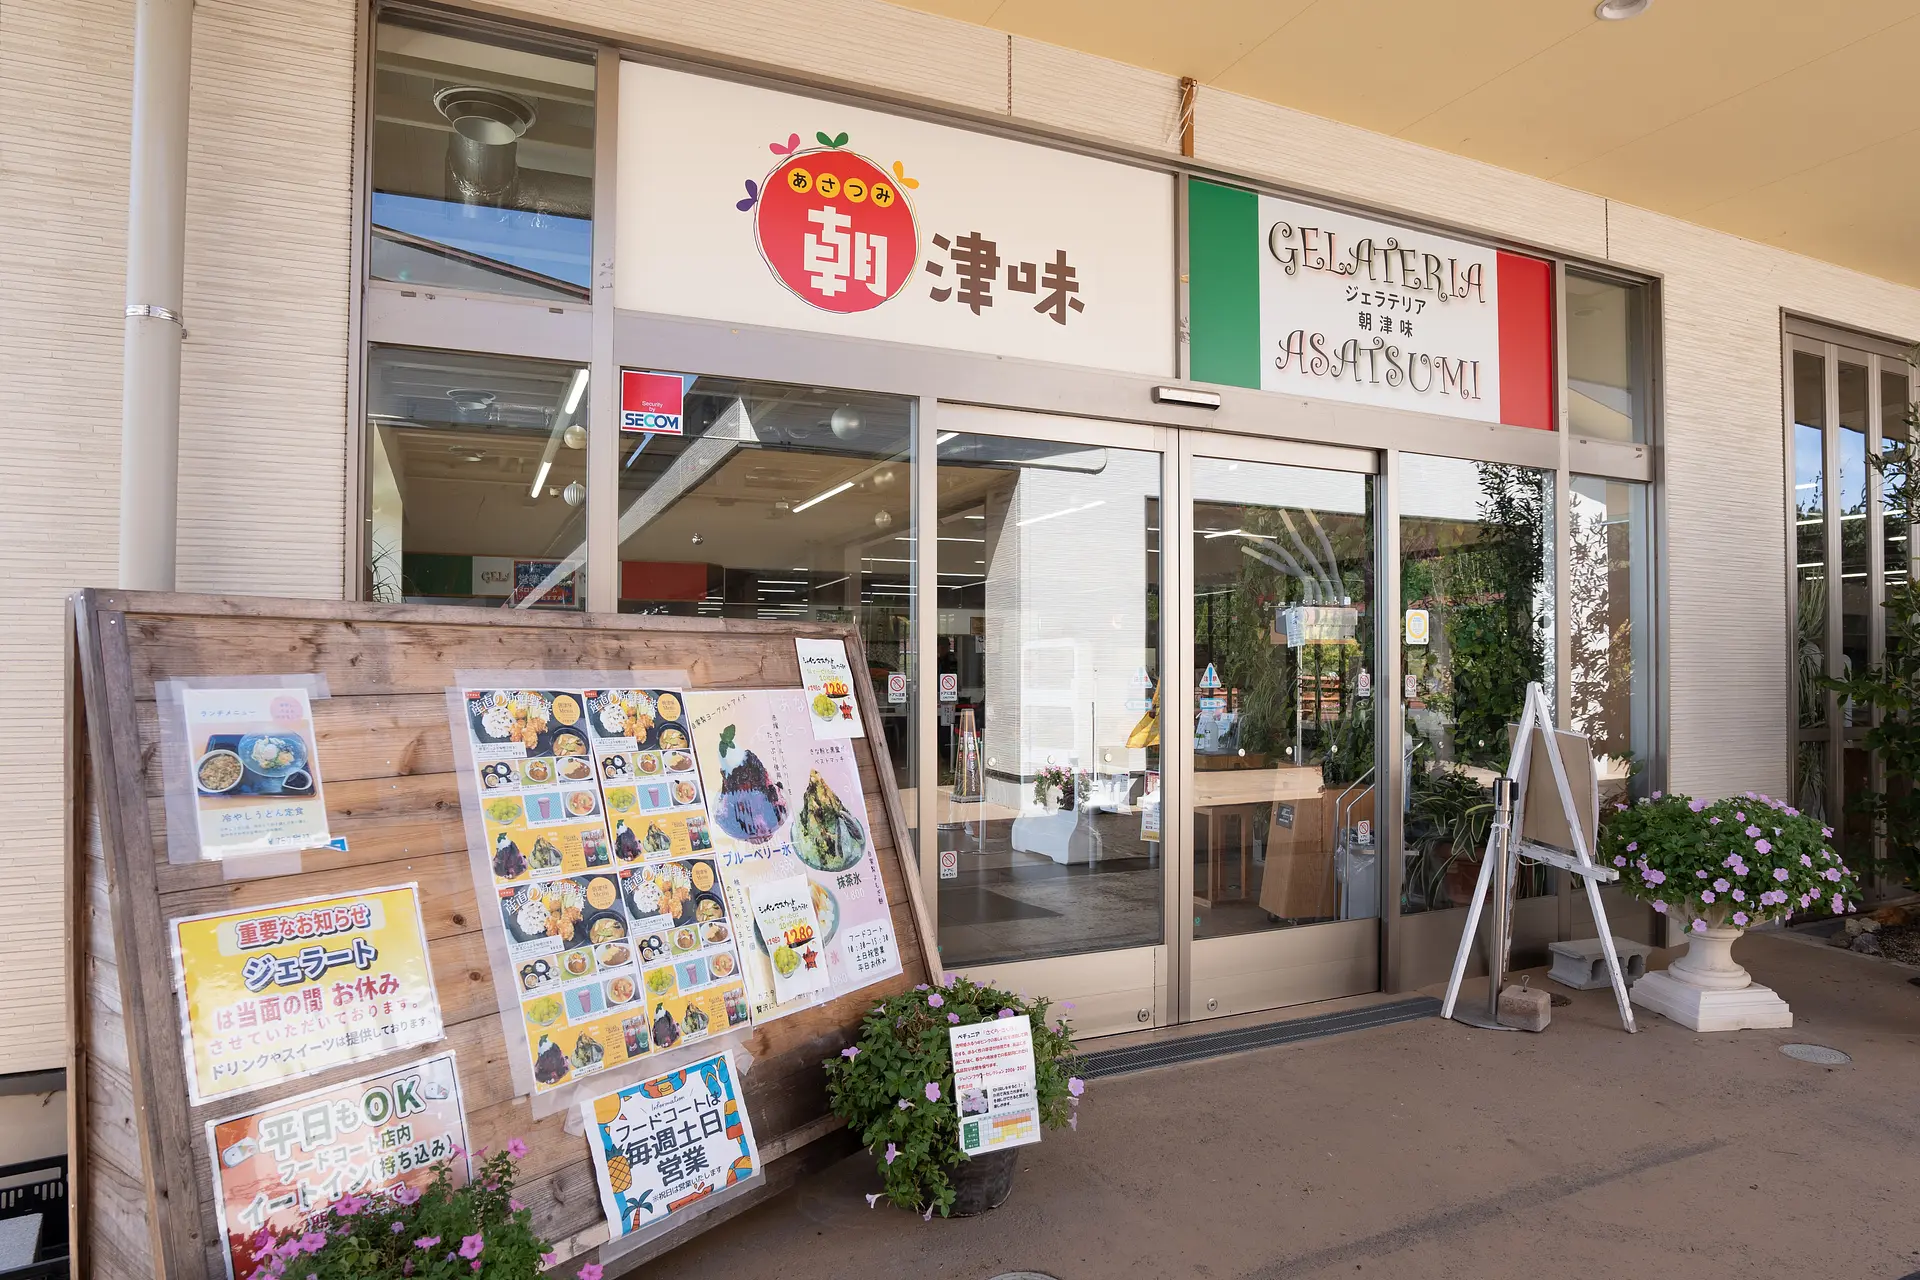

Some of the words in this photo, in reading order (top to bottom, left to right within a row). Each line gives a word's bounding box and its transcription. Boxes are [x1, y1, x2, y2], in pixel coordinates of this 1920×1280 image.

[791, 170, 892, 204] あさつみ
[804, 205, 1085, 325] 朝津味
[1268, 221, 1486, 304] GELATERIA
[1345, 285, 1427, 315] ジェラテリア
[1358, 311, 1414, 338] 朝津味
[1275, 329, 1481, 400] ASATSUMI
[625, 413, 679, 430] SECOM
[641, 400, 663, 409] Security
[823, 682, 849, 695] 1280
[221, 806, 304, 823] 冷やしうどん定食
[722, 841, 793, 867] ブルーベリー氷
[836, 872, 862, 891] 抹茶氷
[238, 905, 370, 946] 重要なお知らせ
[783, 925, 814, 945] 1280
[849, 925, 883, 942] フードコート
[244, 940, 377, 990] ジェラート
[856, 945, 886, 962] 土日祝営業
[857, 957, 887, 972] 平日お休み
[216, 986, 323, 1032] は当面の間
[332, 973, 400, 1007] お休み
[210, 1000, 419, 1056] させていただいております。
[212, 1019, 432, 1081] ドリンクやスイーツは提供しております。
[262, 1078, 423, 1158] 平日もOK
[616, 1092, 722, 1142] フードコートは
[651, 1094, 685, 1111] Information
[280, 1125, 412, 1183] フードコート店内
[625, 1108, 723, 1169] 毎週土日
[657, 1144, 709, 1187] 営業
[652, 1165, 722, 1203] ※祝日は営業いたします
